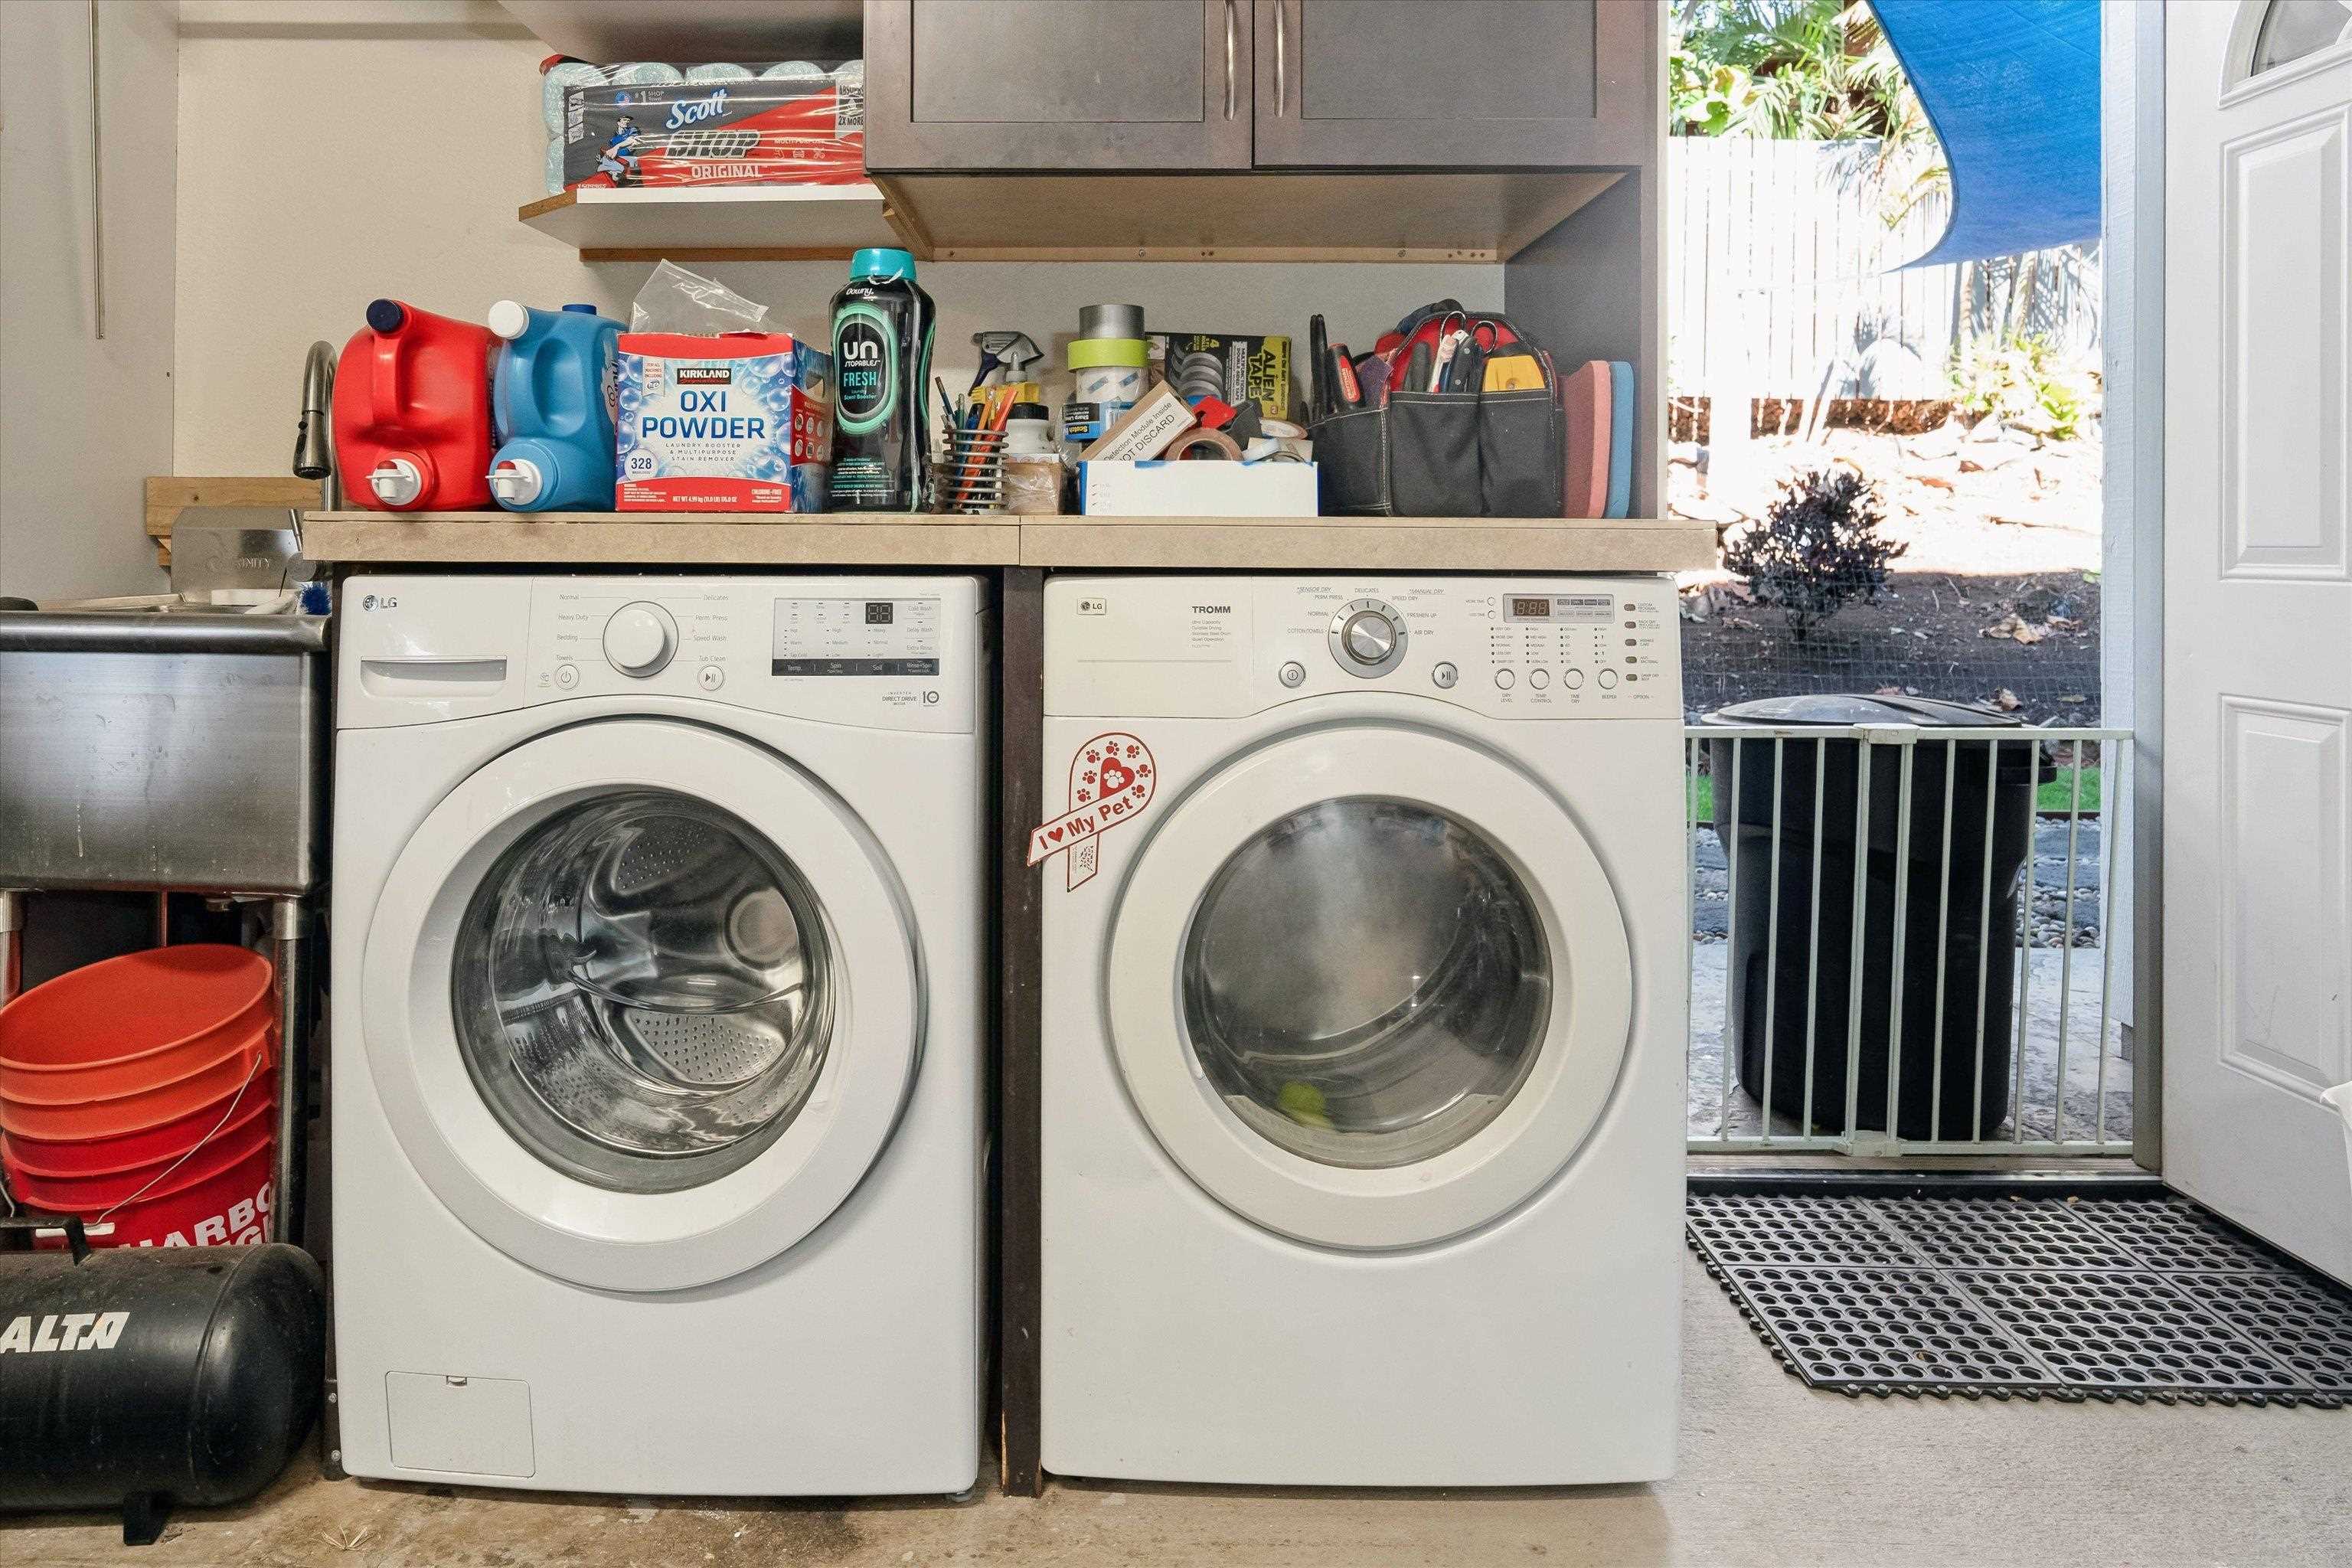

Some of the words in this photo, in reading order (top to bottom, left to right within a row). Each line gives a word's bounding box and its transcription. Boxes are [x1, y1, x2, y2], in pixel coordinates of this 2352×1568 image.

[665, 88, 727, 129] Scott
[838, 116, 846, 126] 2X
[847, 116, 864, 126] MORE
[663, 129, 762, 159] SHOP
[691, 165, 762, 178] ORIGINAL
[846, 288, 873, 296] Downy
[679, 369, 730, 378] KIRKLAND
[844, 371, 877, 387] FRESH
[1249, 354, 1263, 398] TAPE
[1262, 349, 1276, 402] ALIEN
[680, 390, 726, 413] OXI
[642, 416, 766, 439] POWDER
[1068, 425, 1088, 433] Scotch
[1103, 438, 1132, 461] Detection
[1131, 419, 1154, 440] Module
[1152, 402, 1173, 420] Inside
[1119, 448, 1136, 462] OT
[1135, 413, 1175, 452] DISCARD
[631, 457, 652, 469] 328
[380, 598, 398, 609] LG
[1191, 606, 1231, 614] TROMM
[1038, 835, 1049, 851] I
[1066, 815, 1095, 837] My
[1097, 795, 1134, 822] Pet
